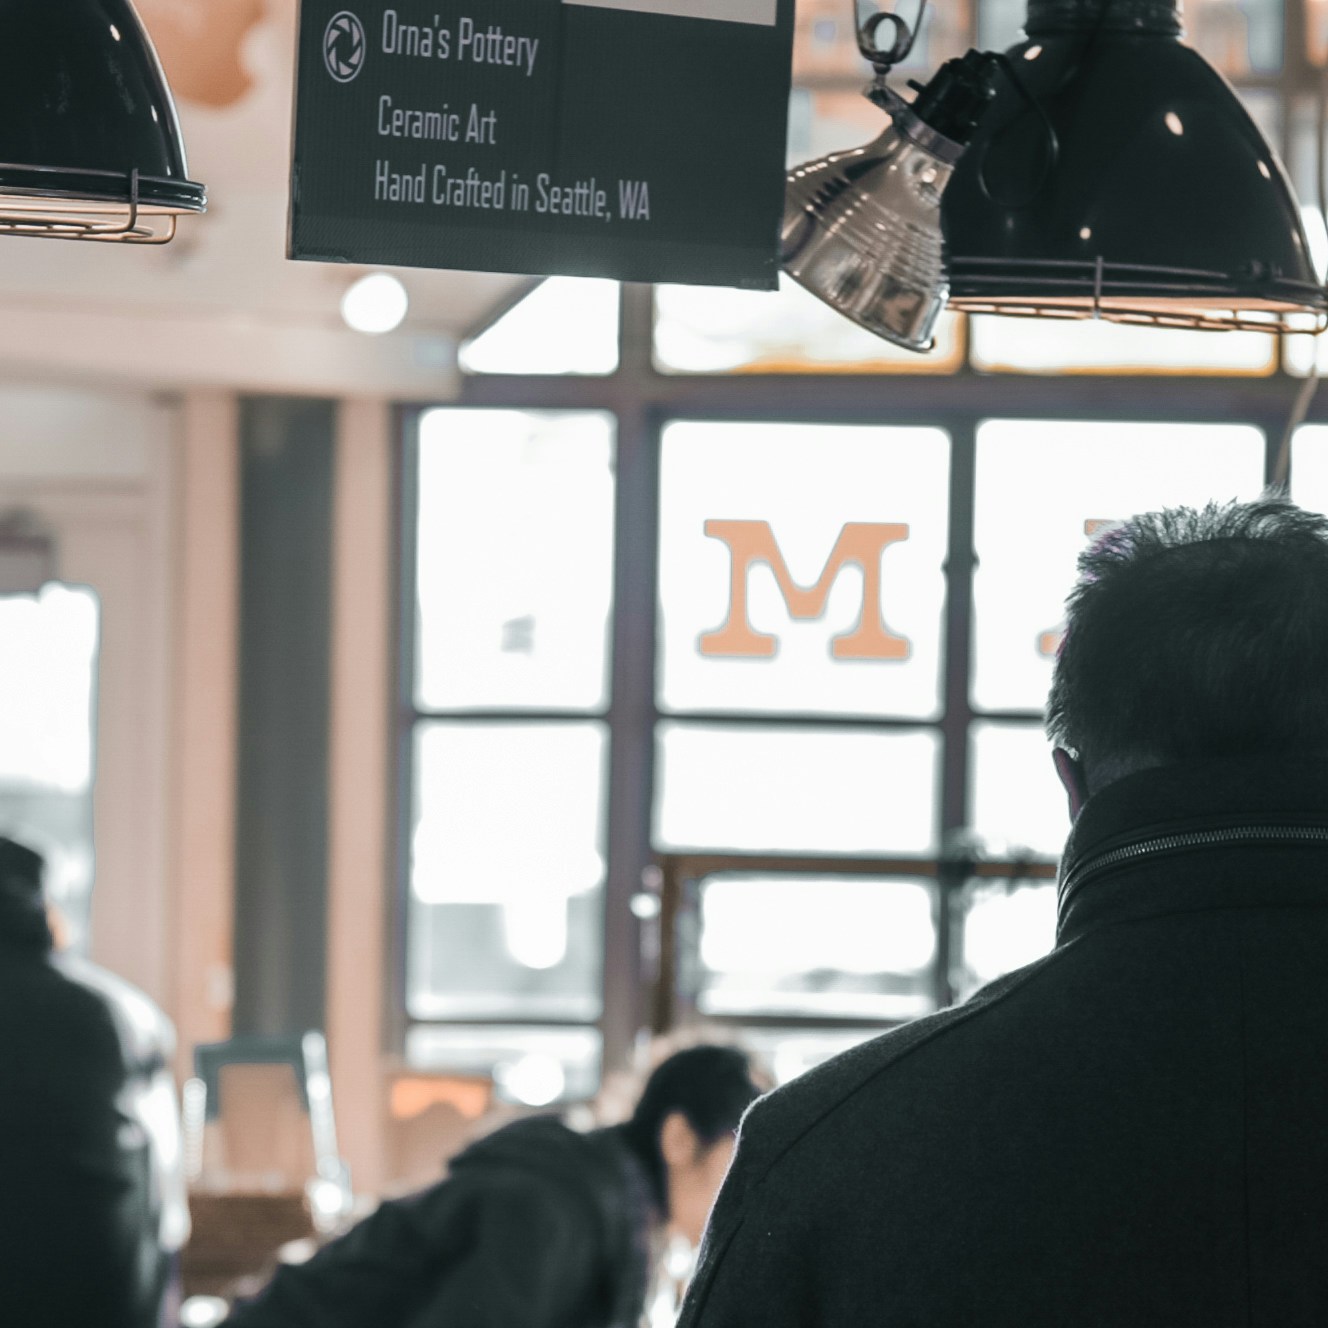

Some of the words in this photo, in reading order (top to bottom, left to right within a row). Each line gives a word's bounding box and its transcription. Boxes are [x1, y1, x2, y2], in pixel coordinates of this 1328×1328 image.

[382, 9, 450, 60] Orna's
[457, 18, 539, 77] Pottery
[377, 95, 460, 143] Ceramic
[465, 103, 497, 145] Art
[374, 160, 425, 202] Hand
[432, 164, 505, 210] Crafted
[511, 173, 530, 211] in
[535, 172, 612, 223] Seattle,
[619, 180, 650, 221] WA
